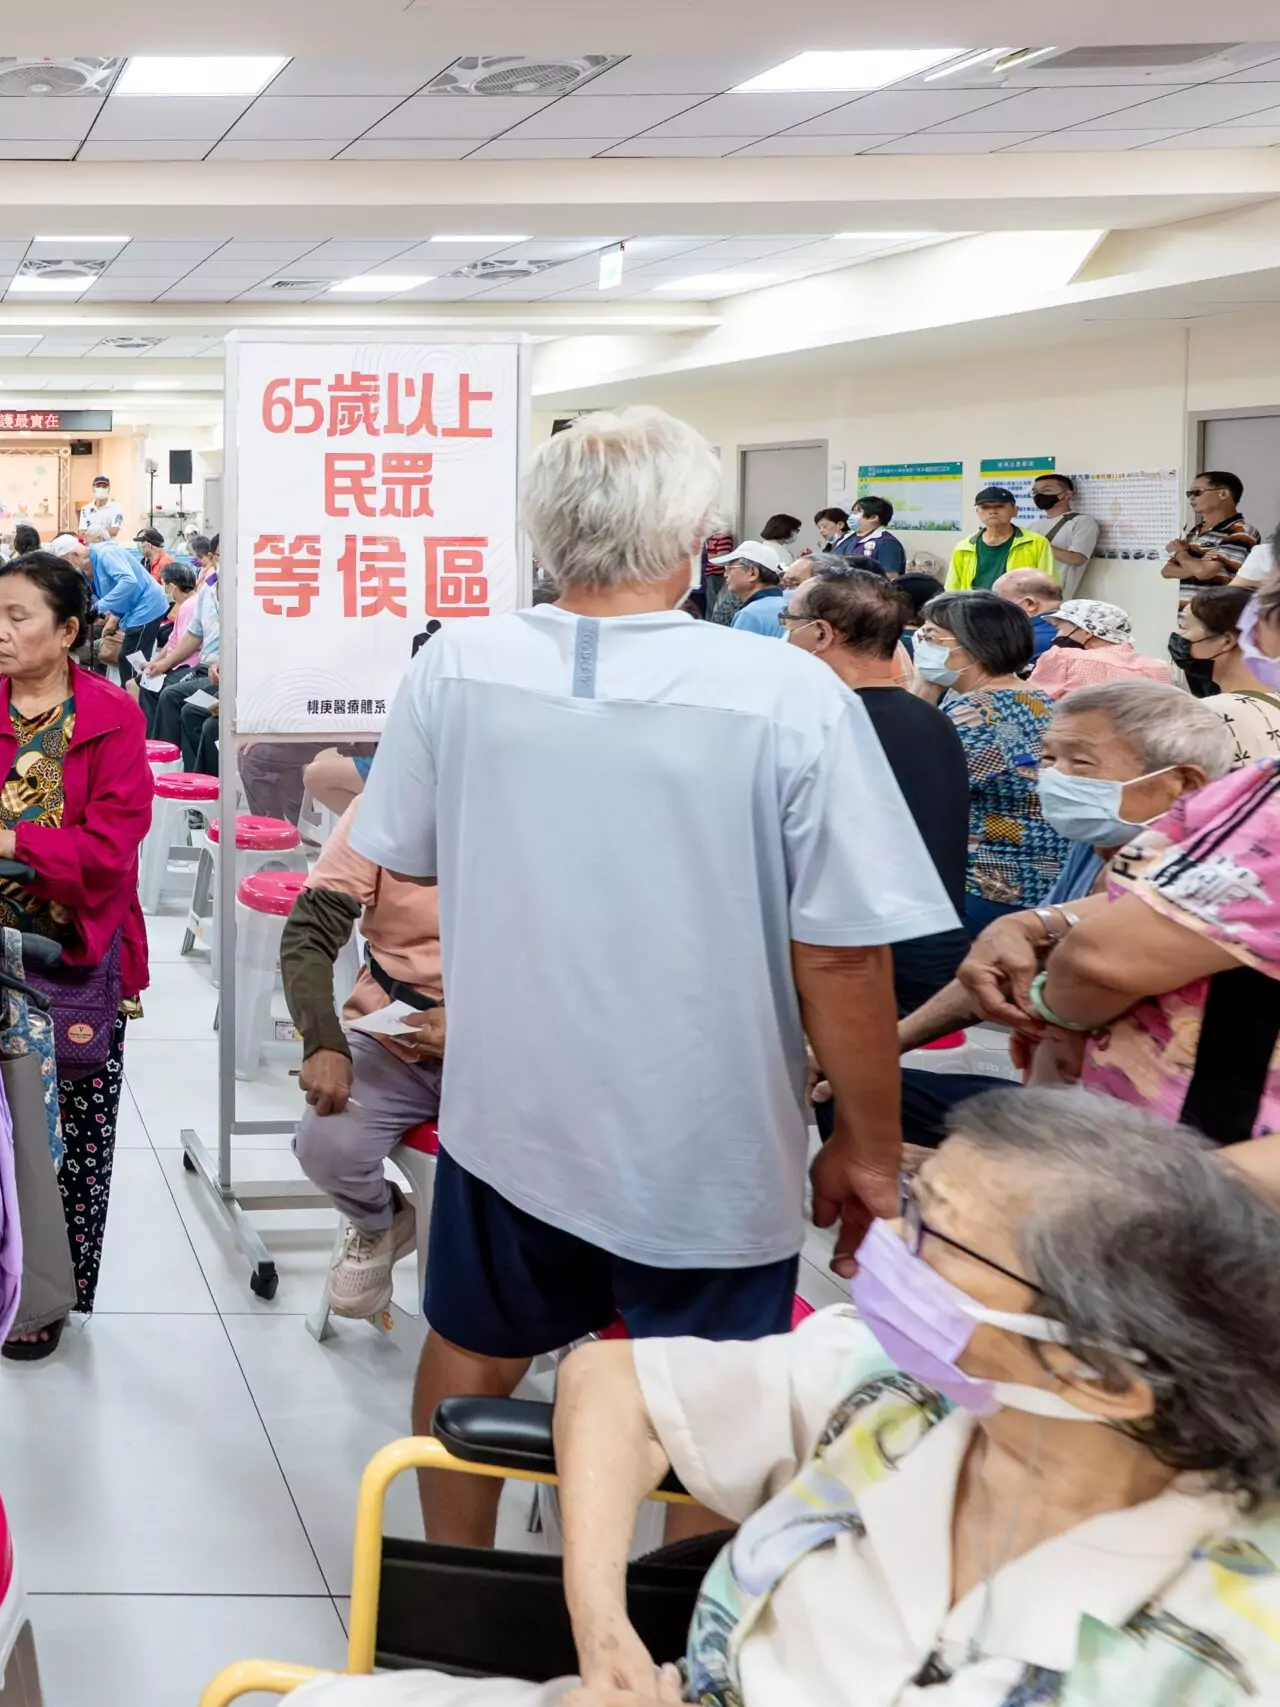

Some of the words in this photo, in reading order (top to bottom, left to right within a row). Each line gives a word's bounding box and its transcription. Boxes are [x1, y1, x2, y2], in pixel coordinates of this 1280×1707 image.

[262, 371, 493, 438] 65歲以上
[324, 452, 434, 518] 民眾
